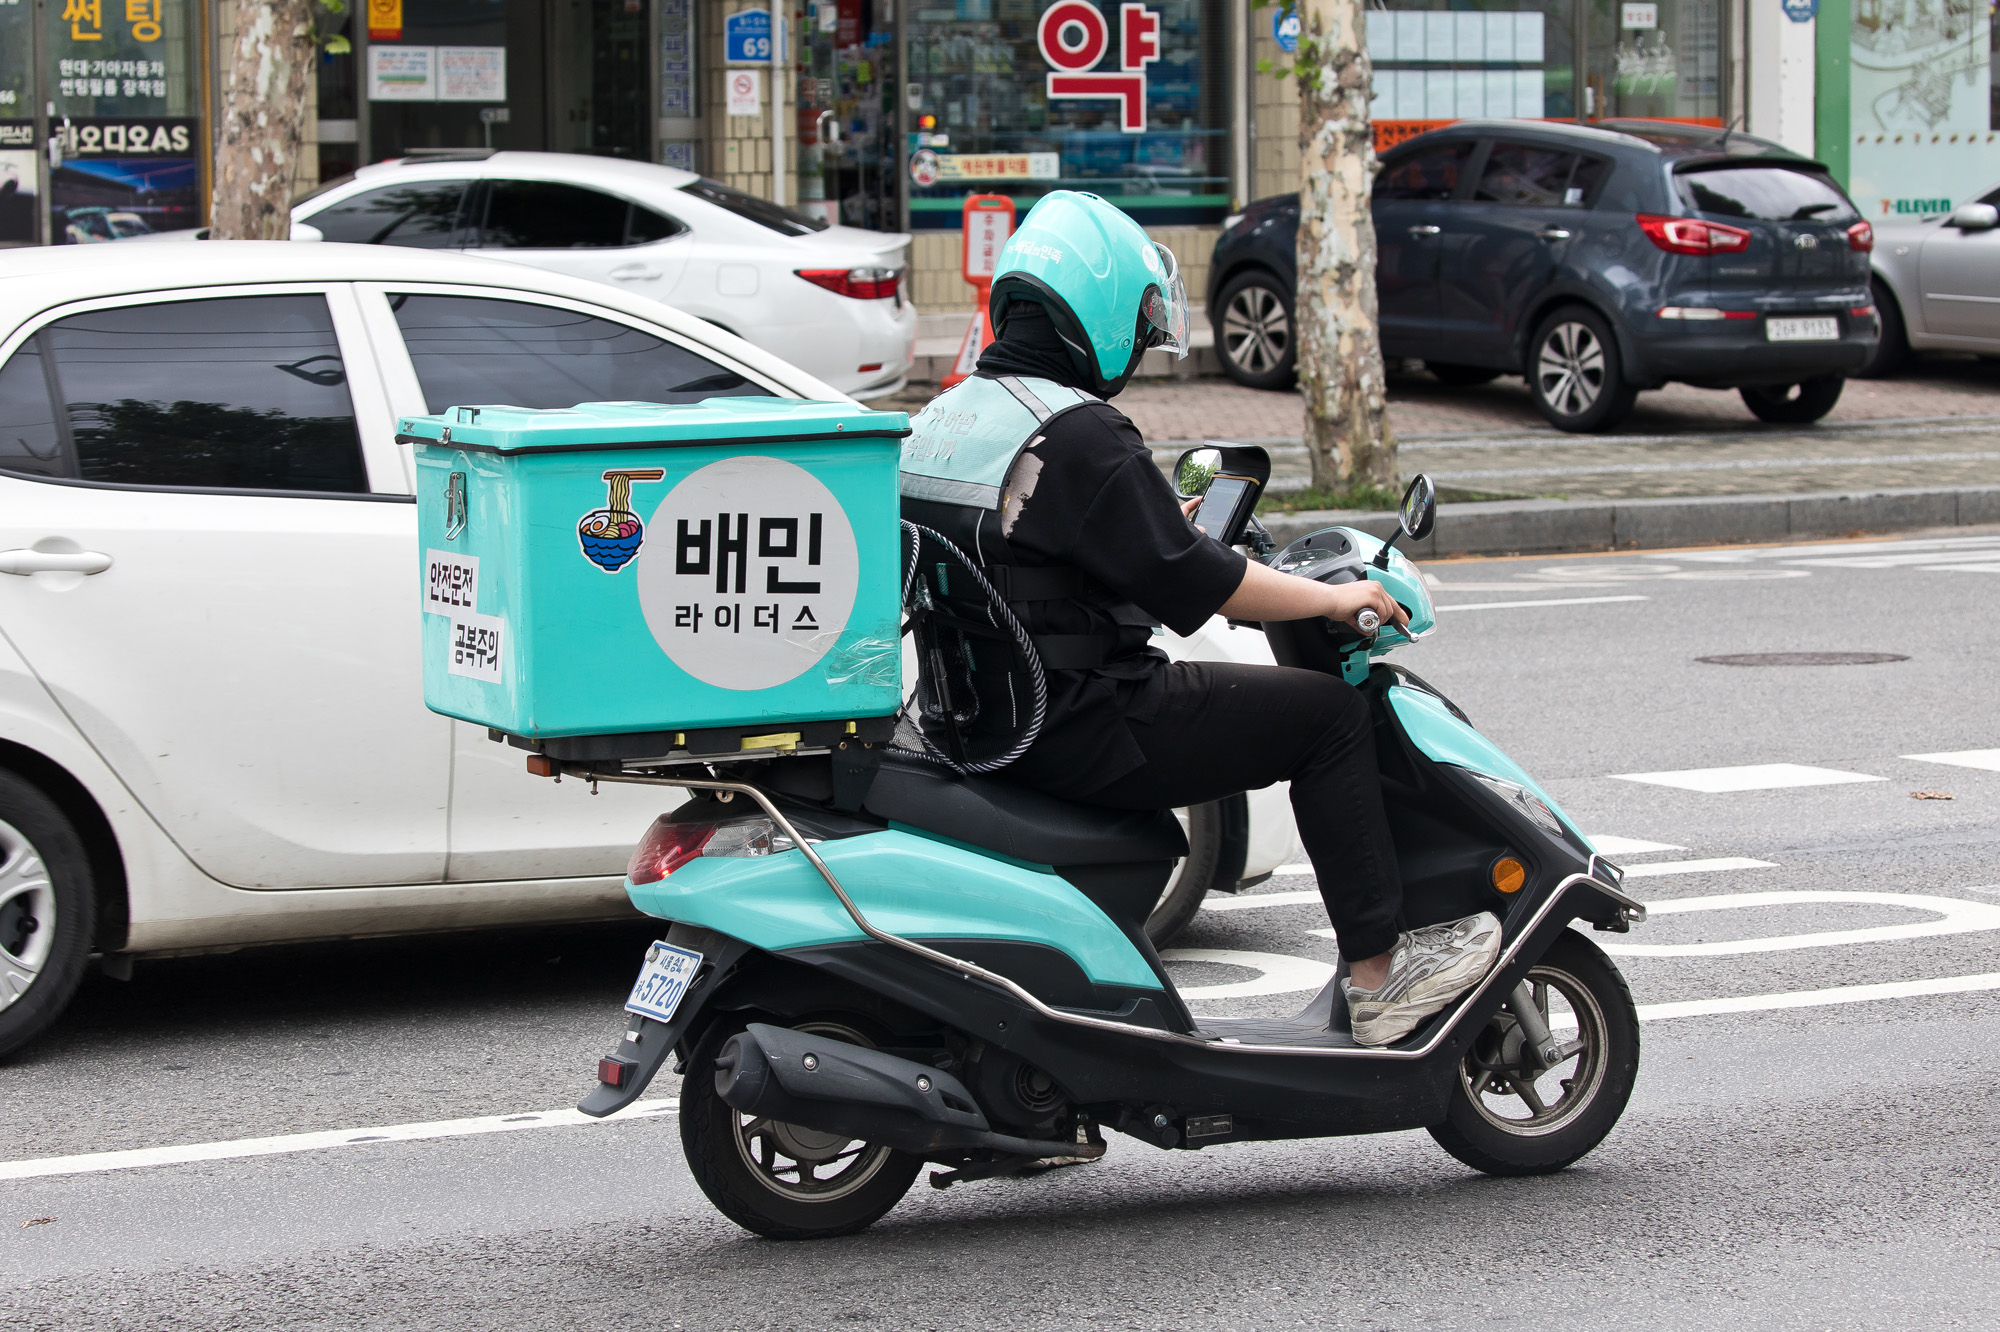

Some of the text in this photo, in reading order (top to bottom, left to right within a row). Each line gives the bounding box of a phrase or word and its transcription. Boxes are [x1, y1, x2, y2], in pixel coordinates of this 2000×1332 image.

[743, 37, 769, 58] 69
[1037, 0, 1160, 133] 약
[901, 433, 958, 463] 족입니까
[675, 512, 823, 594] 배민
[430, 561, 474, 608] 안전운전
[675, 603, 820, 634] 라이더스
[454, 623, 499, 672] 공복주의
